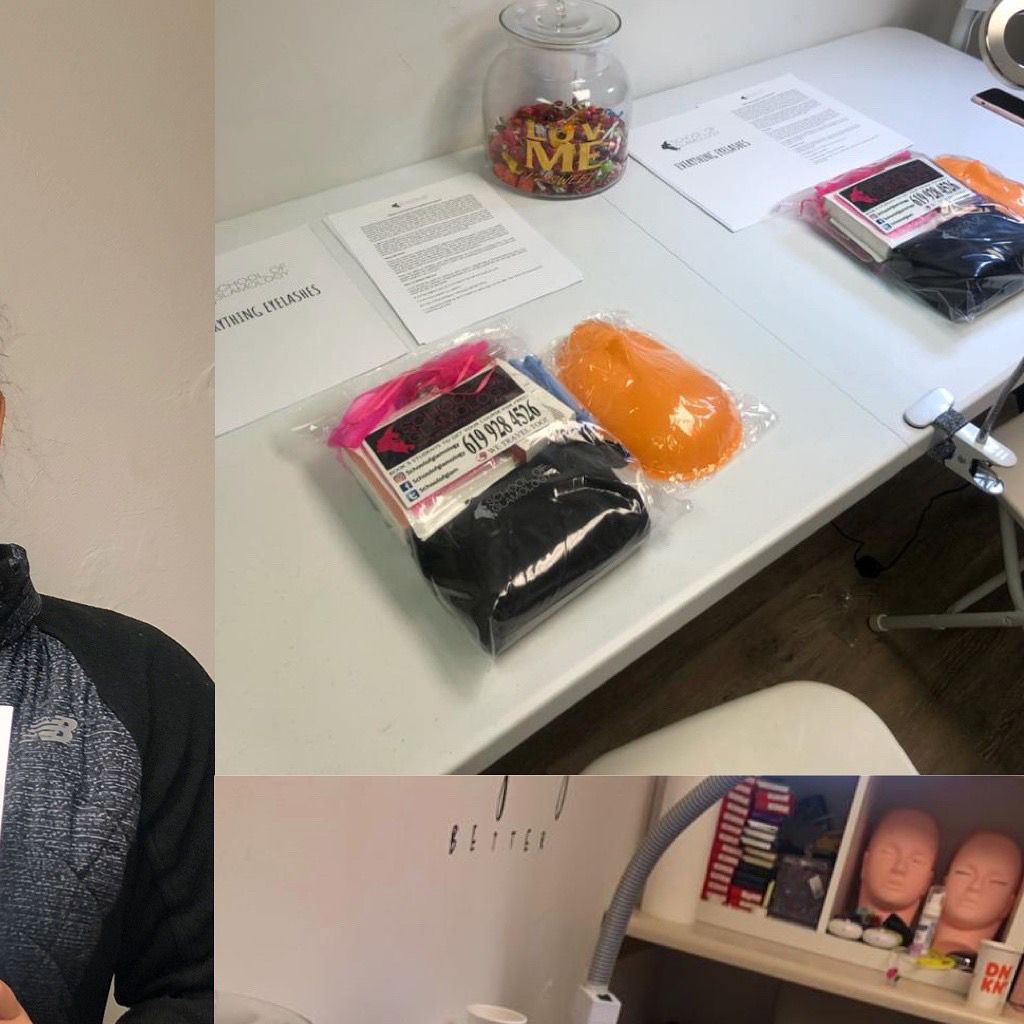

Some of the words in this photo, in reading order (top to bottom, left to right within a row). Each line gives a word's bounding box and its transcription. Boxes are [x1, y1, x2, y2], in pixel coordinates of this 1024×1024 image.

[526, 140, 607, 171] ME
[263, 283, 321, 313] EYELASHES
[462, 428, 488, 454] 619
[484, 416, 512, 440] 928
[509, 401, 542, 428] 4526
[448, 823, 547, 855] BETTER
